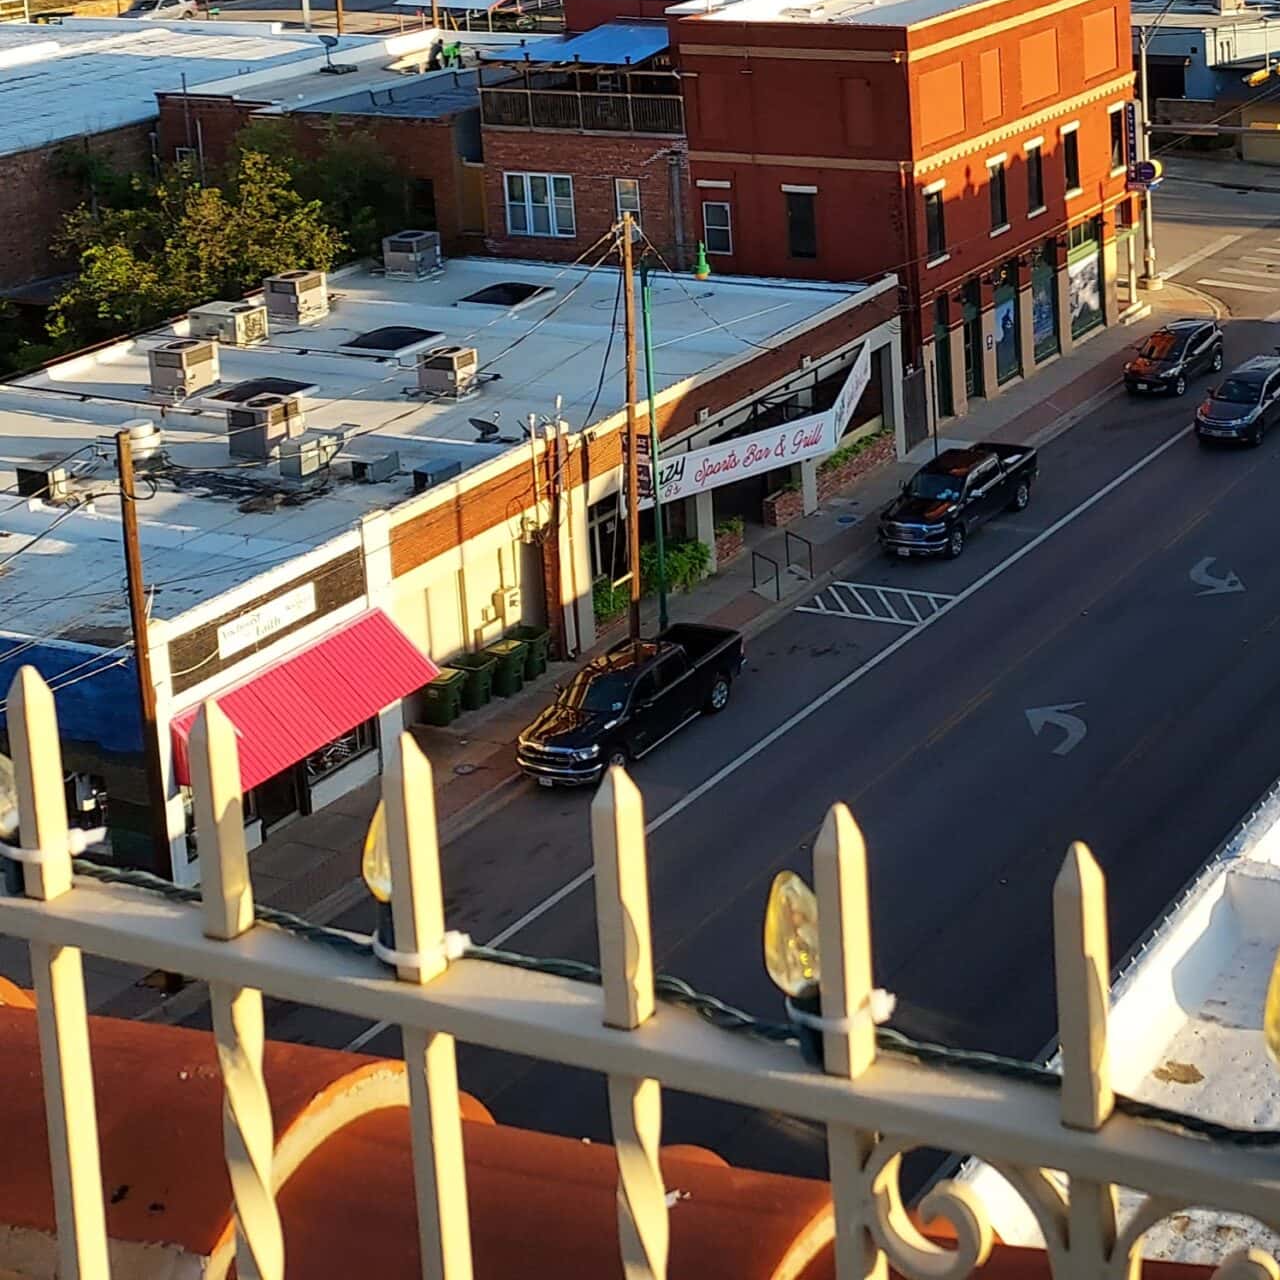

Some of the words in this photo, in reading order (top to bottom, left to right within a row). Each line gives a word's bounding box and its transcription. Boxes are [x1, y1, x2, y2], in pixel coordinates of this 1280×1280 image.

[694, 450, 742, 486] Sports
[743, 443, 771, 468] Bar
[774, 434, 786, 458] &
[791, 423, 824, 455] Grill
